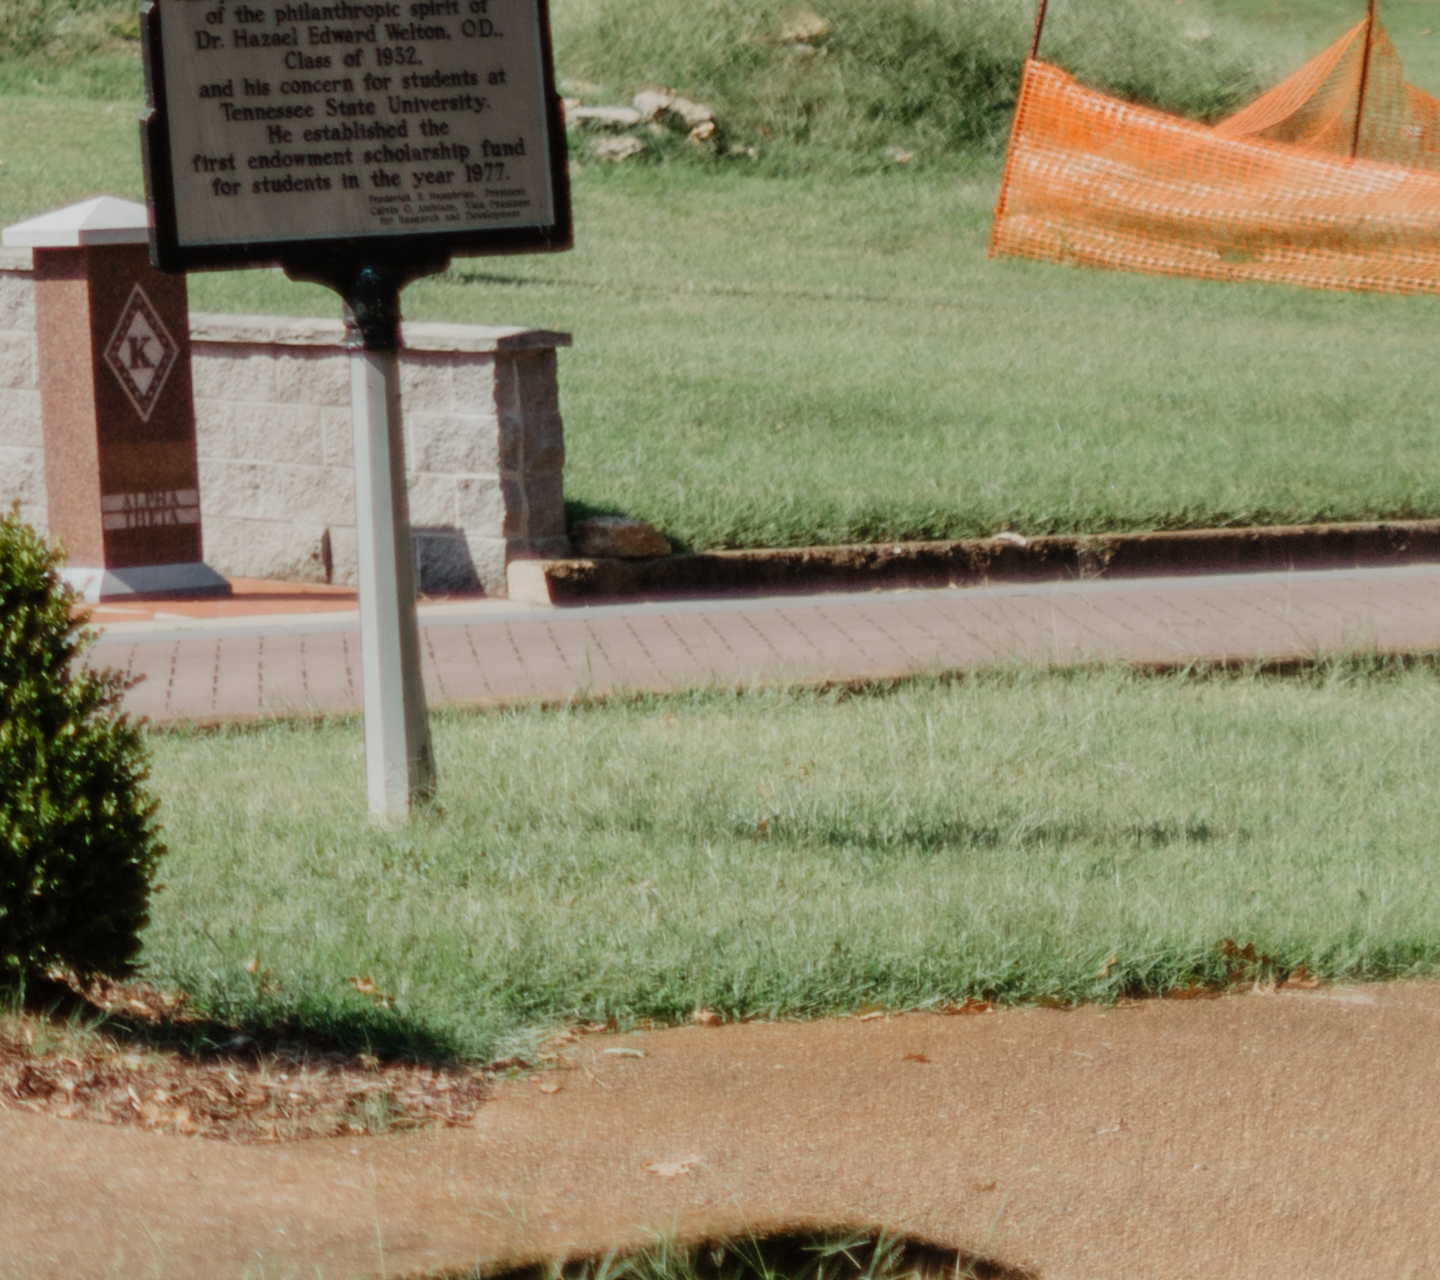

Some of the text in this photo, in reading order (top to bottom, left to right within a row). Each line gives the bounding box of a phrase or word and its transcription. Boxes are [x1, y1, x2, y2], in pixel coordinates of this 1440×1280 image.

[206, 6, 226, 25] of
[235, 4, 265, 24] the
[195, 30, 225, 51] Dr.
[234, 26, 298, 49] Hazael
[308, 23, 377, 46] Edward
[284, 51, 333, 70] Class
[343, 48, 364, 68] of
[199, 67, 507, 99] and his concern for students at
[220, 101, 315, 122] Tennessee
[325, 97, 376, 117] State
[267, 118, 450, 144] He established the
[192, 137, 527, 173] first endowment scholarship fund
[211, 176, 242, 197] for
[253, 171, 333, 193] students
[342, 171, 360, 190] in
[370, 169, 401, 188] the
[412, 168, 455, 189] year
[484, 188, 526, 198] President
[464, 199, 485, 211] Vice
[489, 198, 531, 209] President
[398, 214, 440, 224] Research
[465, 209, 521, 221] Development
[123, 490, 180, 512] ALPHA
[125, 507, 180, 530] THETA
